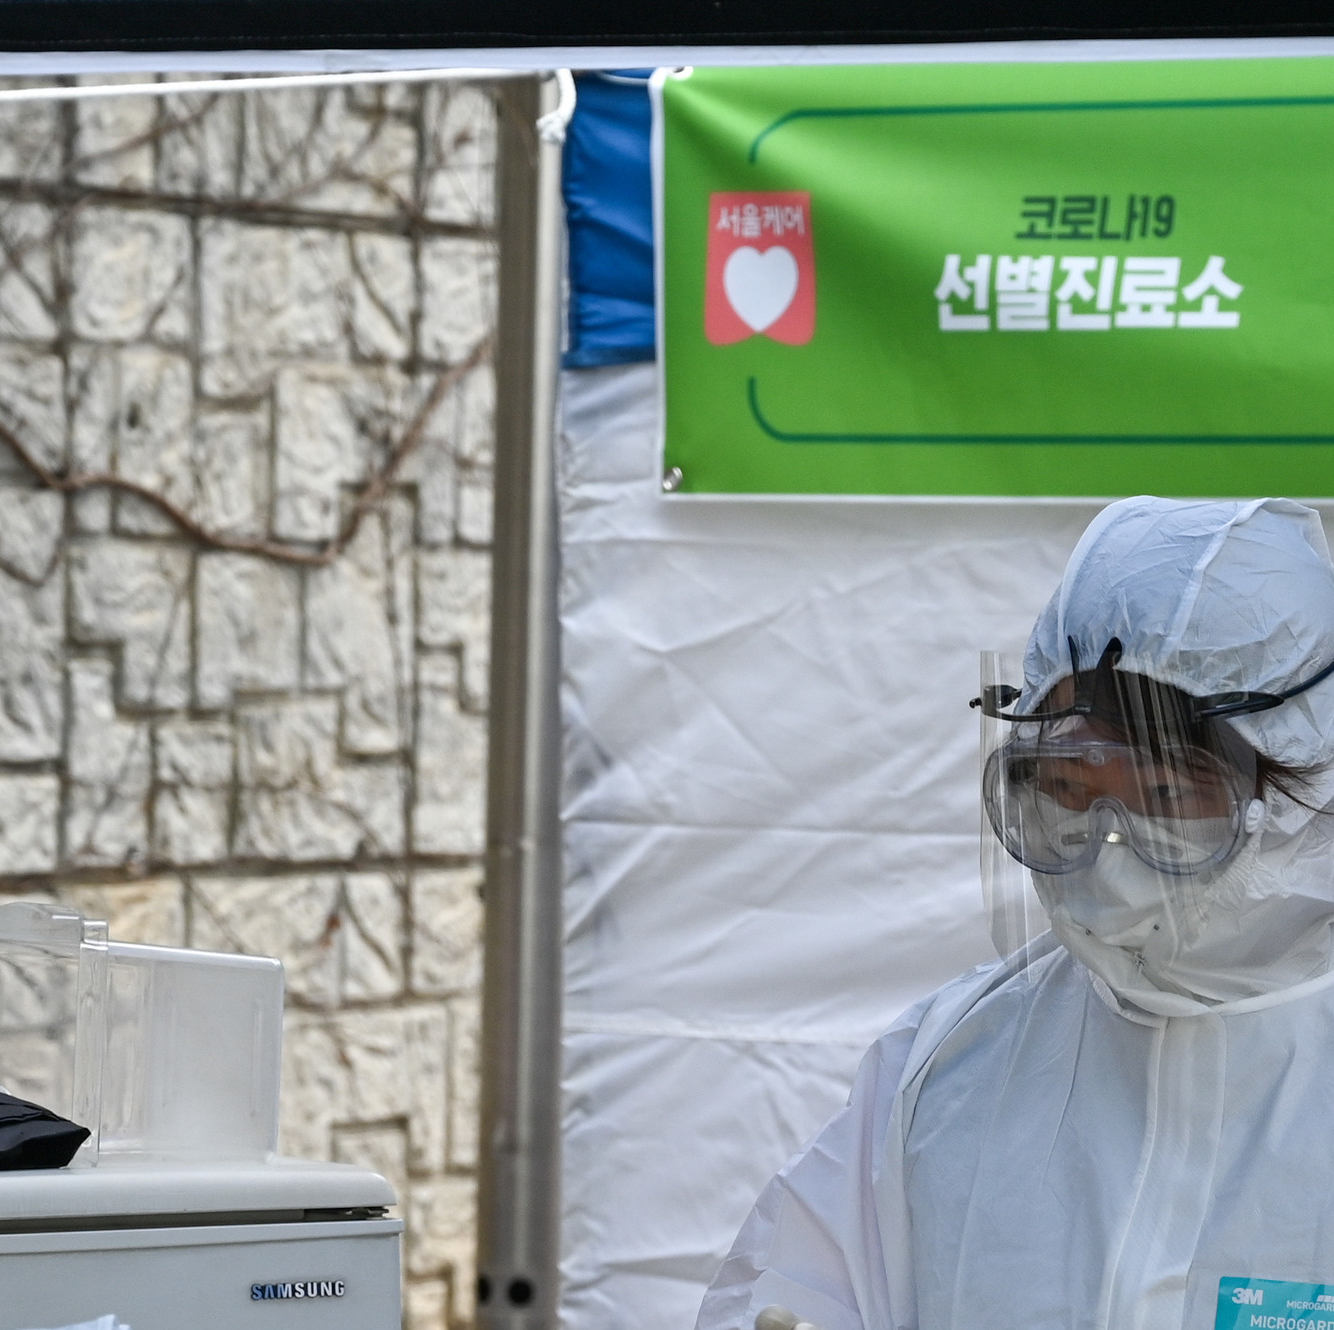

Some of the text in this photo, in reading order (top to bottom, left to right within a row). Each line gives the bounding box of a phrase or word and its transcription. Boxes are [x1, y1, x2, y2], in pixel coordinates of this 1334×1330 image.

[716, 203, 806, 237] 서울케어
[1014, 195, 1175, 241] 코로나19
[935, 254, 1243, 331] 선별진료소
[251, 1280, 345, 1300] SAMSUNG
[1232, 1287, 1264, 1305] 3M
